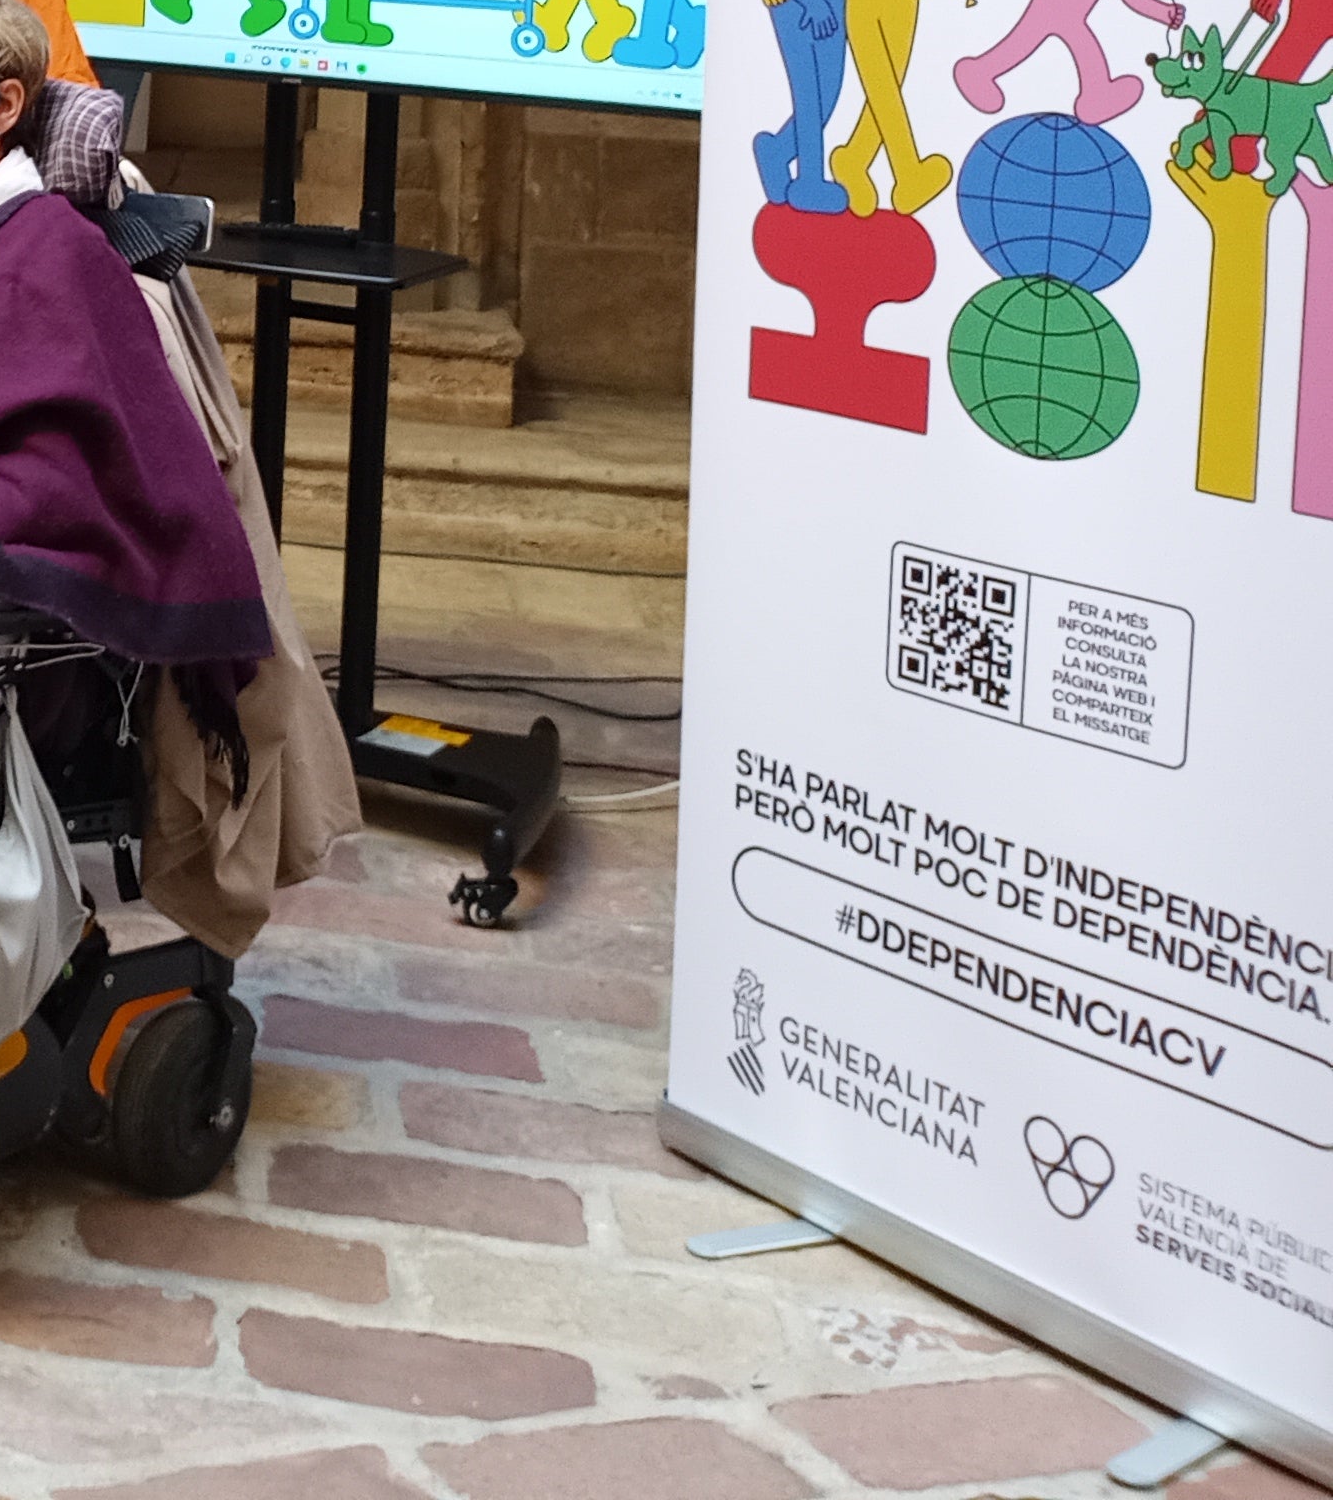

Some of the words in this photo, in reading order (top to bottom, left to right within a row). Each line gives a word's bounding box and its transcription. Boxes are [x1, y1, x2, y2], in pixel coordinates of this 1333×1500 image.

[1057, 616, 1157, 651] INFORMACIÓ
[1068, 600, 1099, 618] PER
[1102, 609, 1113, 622] A
[1116, 611, 1149, 630] MÉS
[1062, 654, 1081, 670] LA
[1085, 660, 1148, 687] NOSTRA
[1065, 636, 1147, 667] CONSULTA
[1052, 688, 1153, 726] COMPARTEIX
[1113, 685, 1147, 706] WEB
[1052, 707, 1070, 723] EL
[1074, 712, 1151, 745] MISSATGE
[735, 748, 797, 794] S'HA
[805, 771, 918, 834] PARLAT
[924, 812, 1015, 869] MOLT
[1023, 846, 1333, 983] D'INDEPENDÈNCI
[735, 783, 815, 834] PERÒ
[822, 814, 907, 868] MOLT
[913, 847, 988, 898] POC
[997, 878, 1044, 921] DE
[1053, 896, 1331, 1025] DEPENDÈNCIA.
[834, 903, 1227, 1078] #DDEPENDENCIACV
[779, 1016, 986, 1128] GENERALITAT
[780, 1049, 978, 1167] VALENCIANA
[1138, 1172, 1241, 1233] SISTEMA
[1136, 1223, 1237, 1285] SERVEIS
[1241, 1271, 1333, 1330] SOCIAL
[1257, 1248, 1288, 1281] DE
